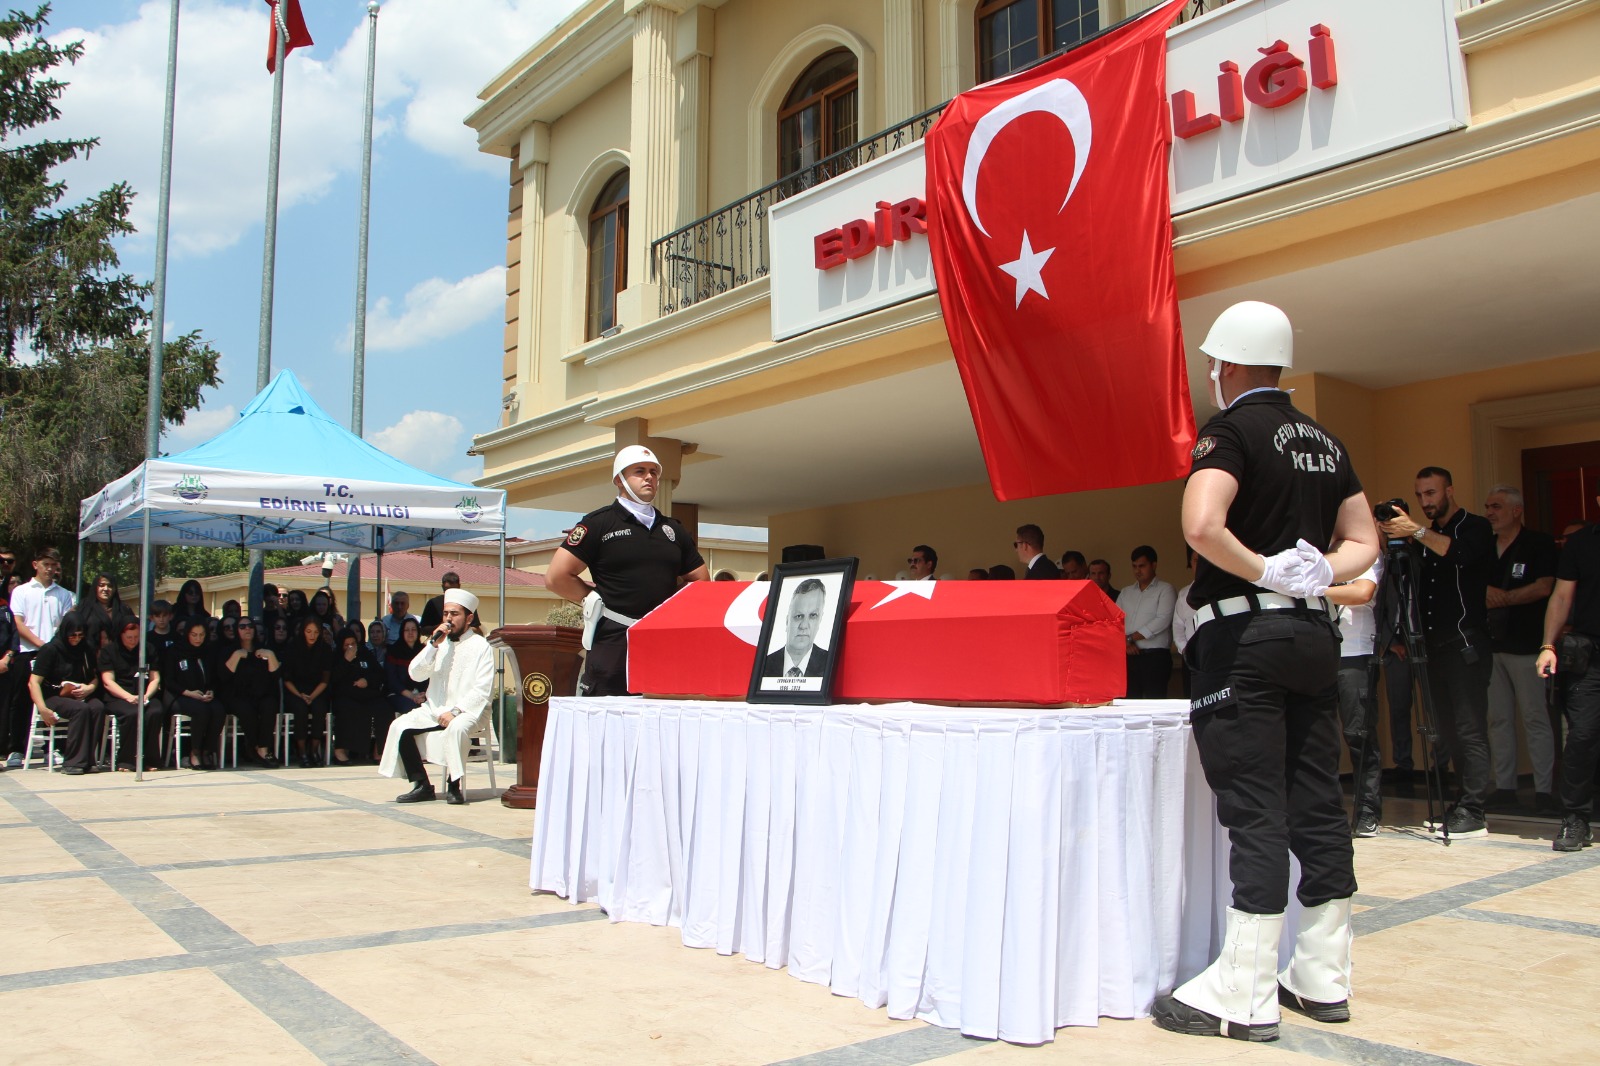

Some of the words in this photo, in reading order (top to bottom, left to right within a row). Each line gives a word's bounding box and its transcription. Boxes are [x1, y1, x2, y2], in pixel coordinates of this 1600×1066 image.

[813, 196, 929, 270] EDİR
[1166, 23, 1338, 146] LİĞİ
[323, 483, 354, 499] T.C.
[259, 496, 328, 513] EDİRNE
[336, 502, 410, 519] VALİLİĞİ
[1202, 686, 1231, 707] KUVVET
